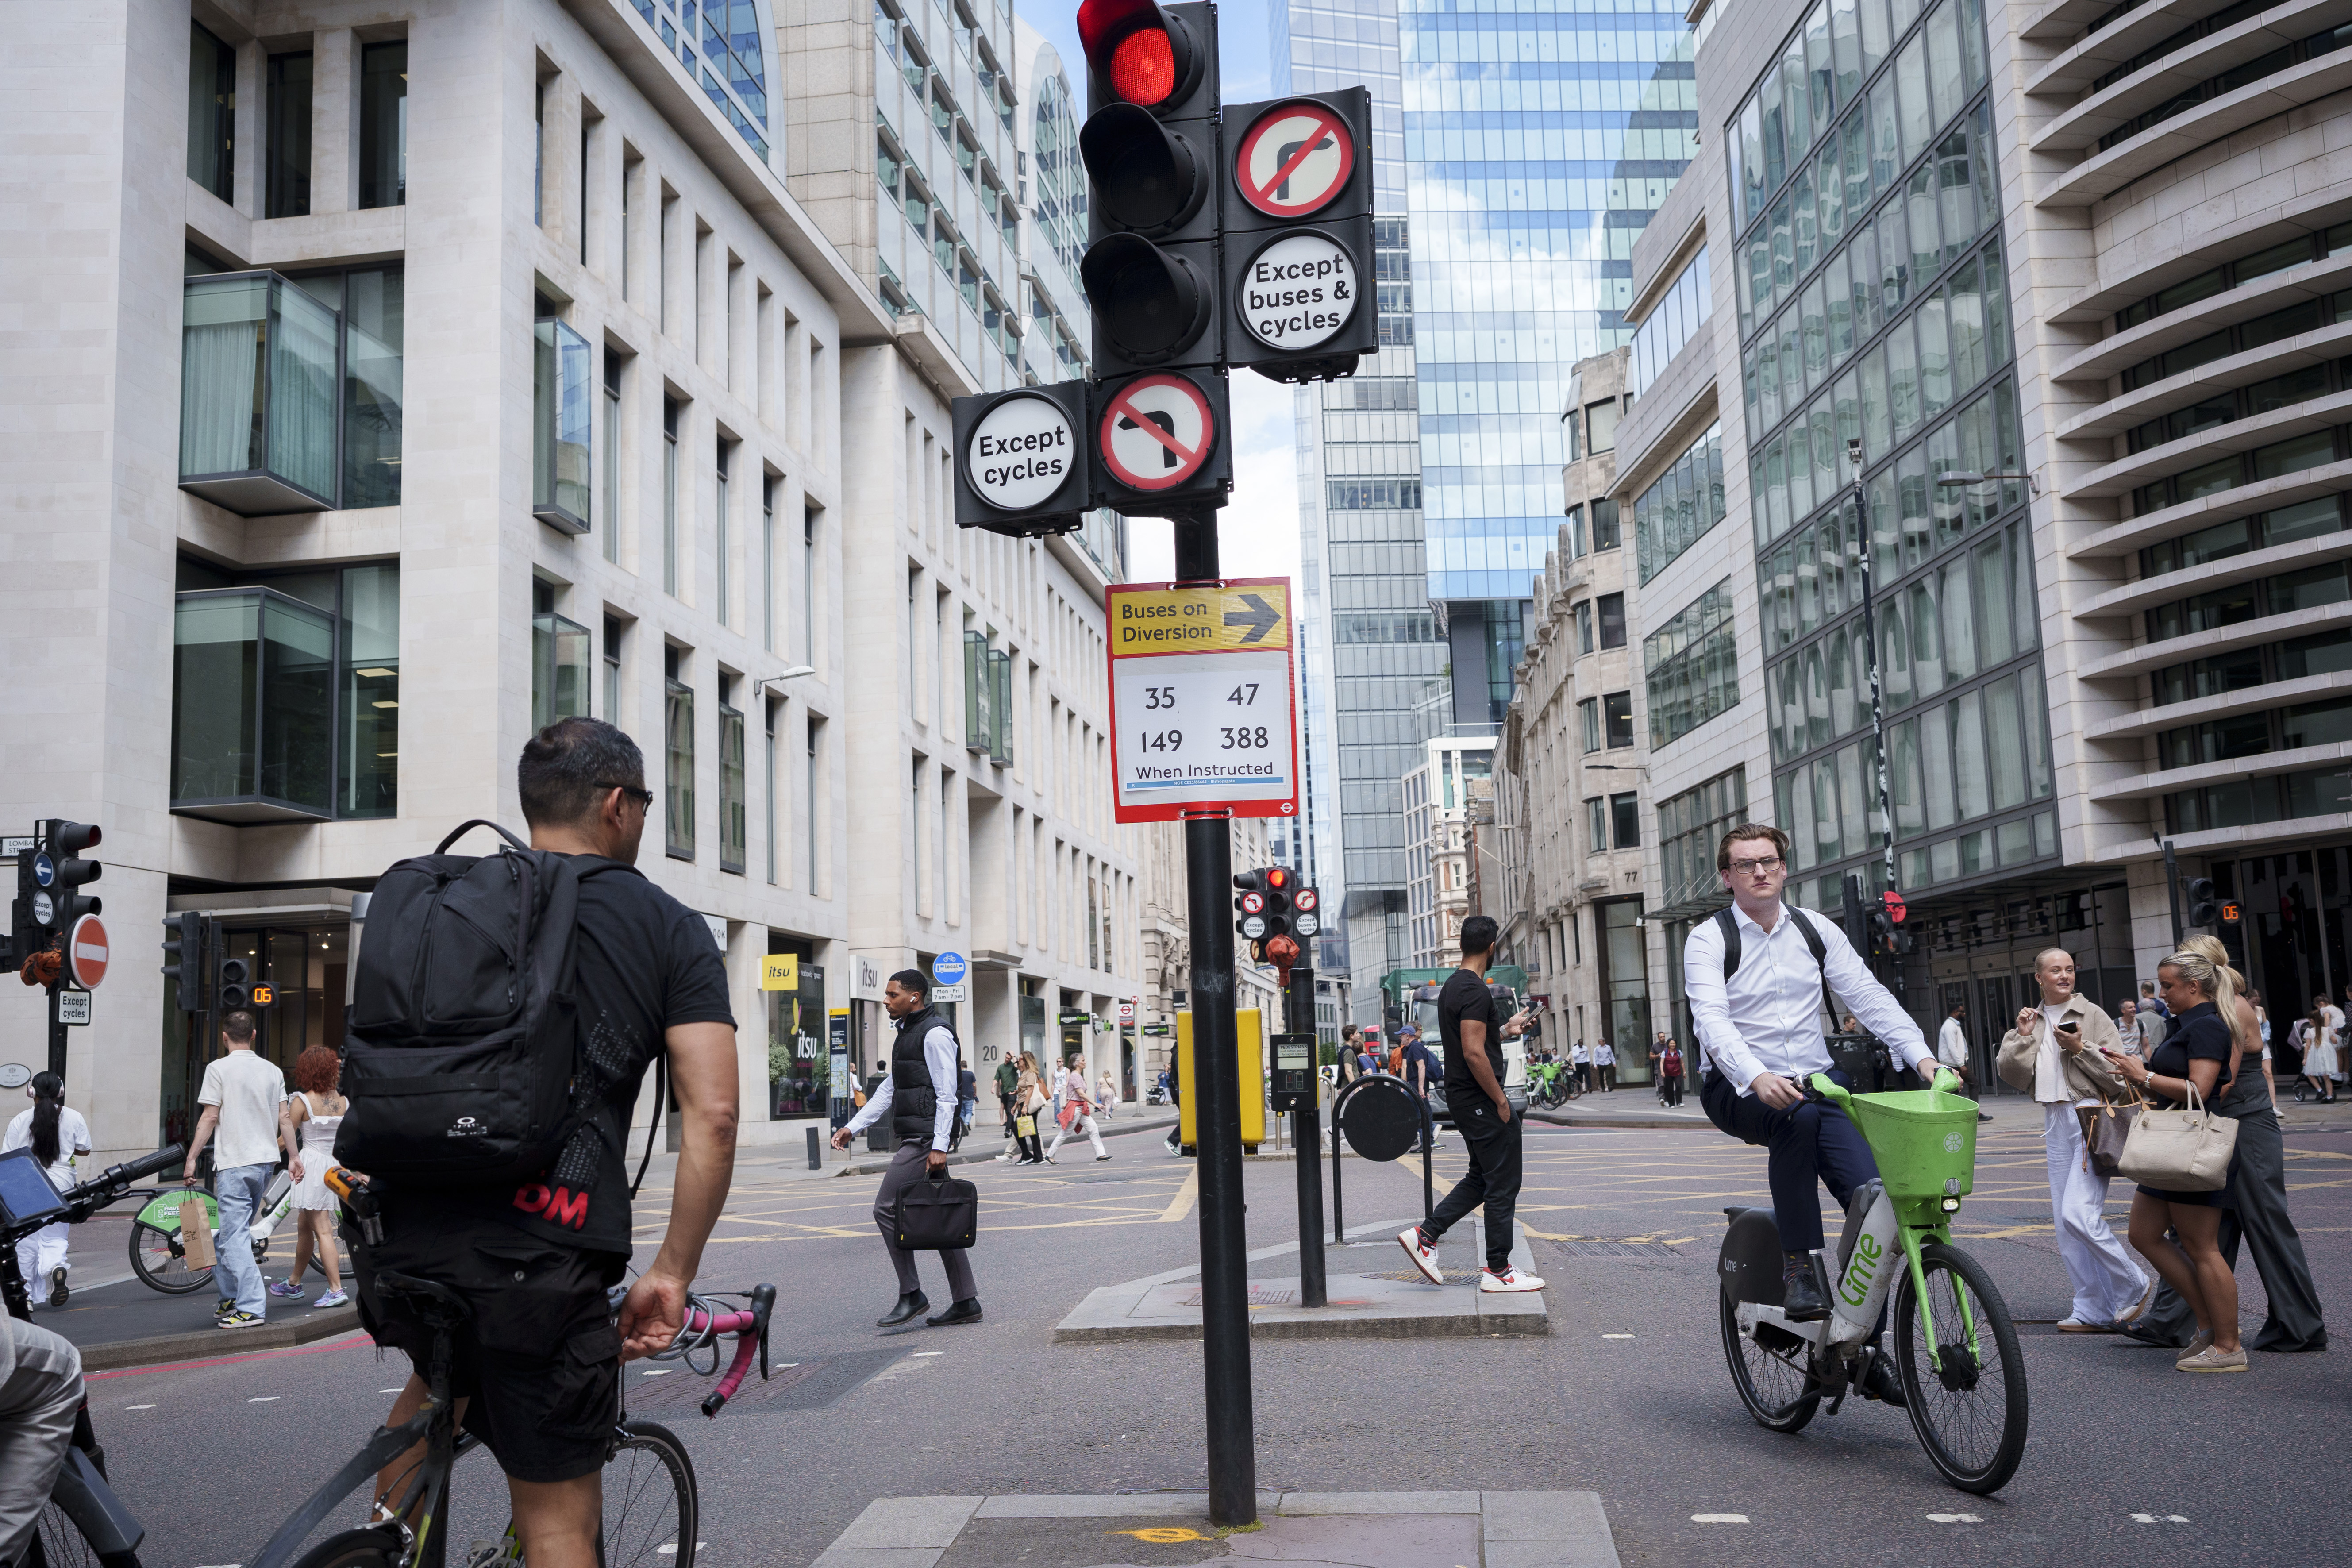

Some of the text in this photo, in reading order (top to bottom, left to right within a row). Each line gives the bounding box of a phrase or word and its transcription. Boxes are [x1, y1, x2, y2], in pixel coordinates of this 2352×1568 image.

[1255, 254, 1344, 285] Except
[1249, 280, 1351, 311] buses &
[1259, 311, 1340, 339] cycles
[979, 425, 1065, 458] Except
[984, 459, 1063, 487] cycles
[1122, 603, 1207, 619] Buses on
[1123, 624, 1212, 642] Diversion
[1145, 687, 1175, 709] 35
[1227, 683, 1259, 705] 47
[1142, 729, 1182, 753] 149
[1220, 726, 1269, 749] 388
[1136, 762, 1274, 779] When Instructed
[1624, 871, 1637, 882] 77
[35, 900, 51, 909] Except
[2223, 905, 2239, 920] 06
[713, 928, 725, 938] OOK
[769, 966, 790, 978] itsu
[863, 961, 878, 988] itsu
[63, 996, 87, 1007] Except
[254, 987, 272, 1003] 06
[63, 1009, 85, 1019] cycles
[797, 1029, 817, 1059] itsu
[983, 1045, 997, 1061] 20
[1725, 1258, 1737, 1272] Lime
[1839, 1233, 1882, 1306] Lime
